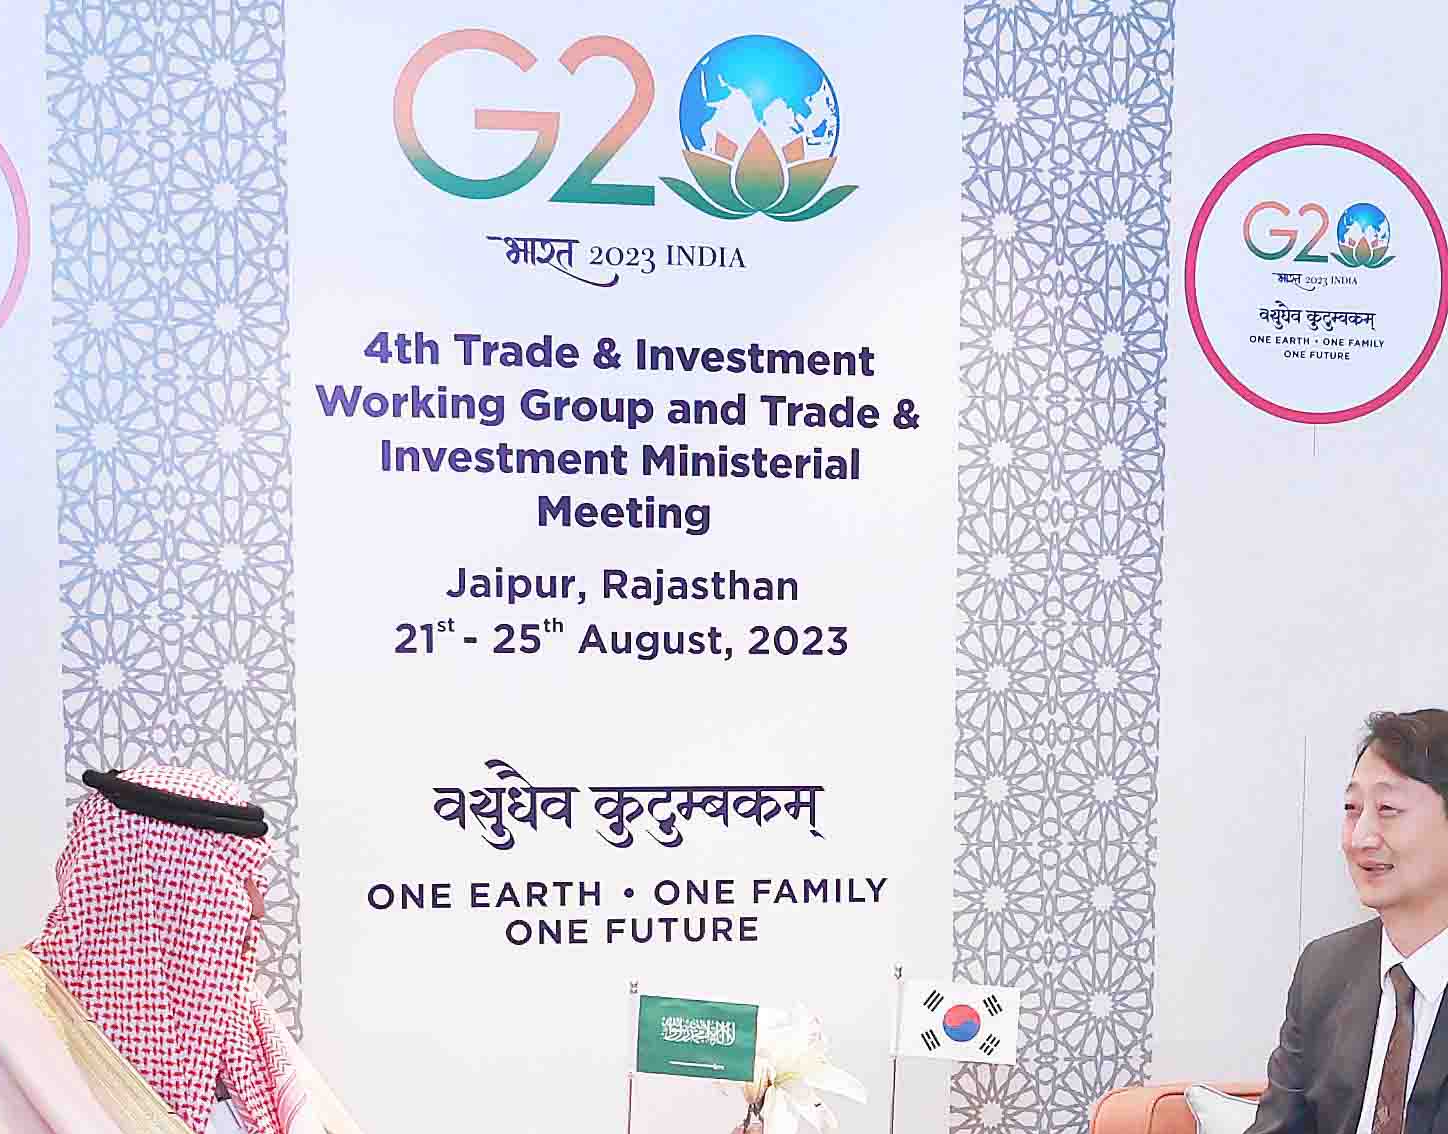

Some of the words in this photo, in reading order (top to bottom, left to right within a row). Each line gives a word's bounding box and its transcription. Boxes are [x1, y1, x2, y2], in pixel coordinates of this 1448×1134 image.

[393, 28, 859, 222] G20
[1243, 200, 1397, 269] G20
[589, 245, 656, 274] 2023
[666, 243, 746, 269] INDIA
[1305, 276, 1328, 287] 2023
[1331, 274, 1358, 286] INDIA
[364, 330, 440, 366] 4th
[454, 333, 579, 369] Trade
[592, 337, 622, 370] &
[636, 338, 875, 377] Investment
[1249, 335, 1271, 345] ONE
[1275, 336, 1310, 345] EARTH
[1323, 338, 1344, 347] ONE
[1348, 338, 1384, 349] FAMILY
[1283, 350, 1306, 360] ONE
[1309, 350, 1350, 361] FUTURE
[315, 384, 506, 427] Working
[519, 388, 654, 430] Group
[667, 393, 746, 427] and
[760, 394, 880, 430] Trade
[892, 399, 920, 431] &
[380, 440, 627, 476] Investment
[641, 444, 860, 481] Ministerial
[537, 495, 712, 535] Meeting
[446, 568, 586, 604] Jaipur,
[602, 570, 799, 606] Rajasthan
[394, 617, 455, 655] 21st
[492, 617, 564, 655] 25th
[579, 624, 734, 661] August,
[747, 625, 849, 656] 2023
[366, 882, 452, 910] ONE
[470, 880, 603, 907] EARTH
[653, 878, 735, 906] ONE
[752, 876, 888, 904] FAMILY
[505, 918, 589, 946] ONE
[606, 916, 759, 944] FUTURE
